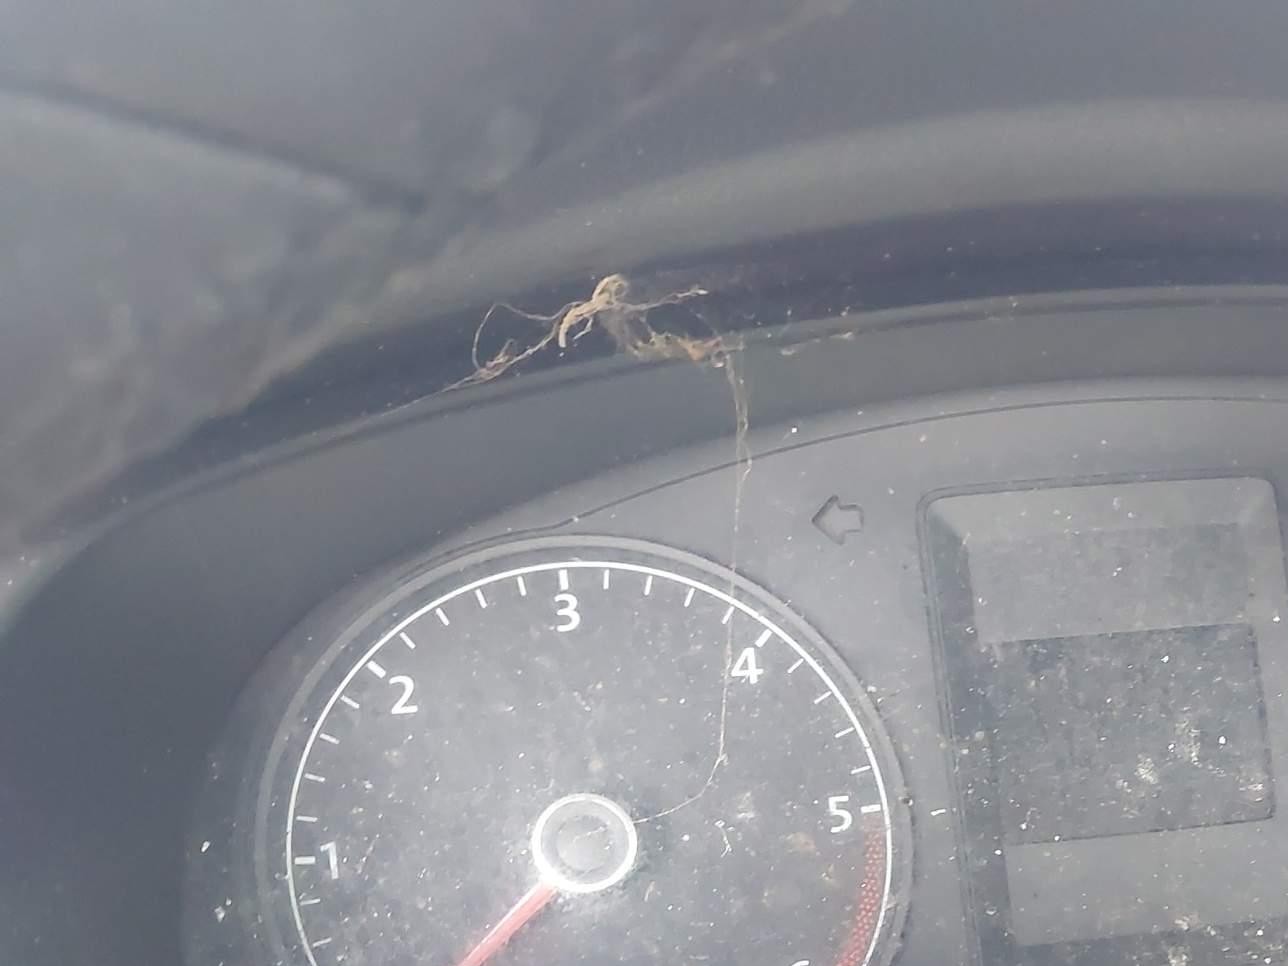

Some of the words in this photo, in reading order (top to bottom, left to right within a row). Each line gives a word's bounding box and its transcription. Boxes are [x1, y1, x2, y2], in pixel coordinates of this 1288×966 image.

[554, 593, 580, 632] 3
[731, 647, 763, 684] 4
[389, 675, 418, 715] 2
[829, 796, 852, 833] 5
[320, 842, 339, 879] 1
